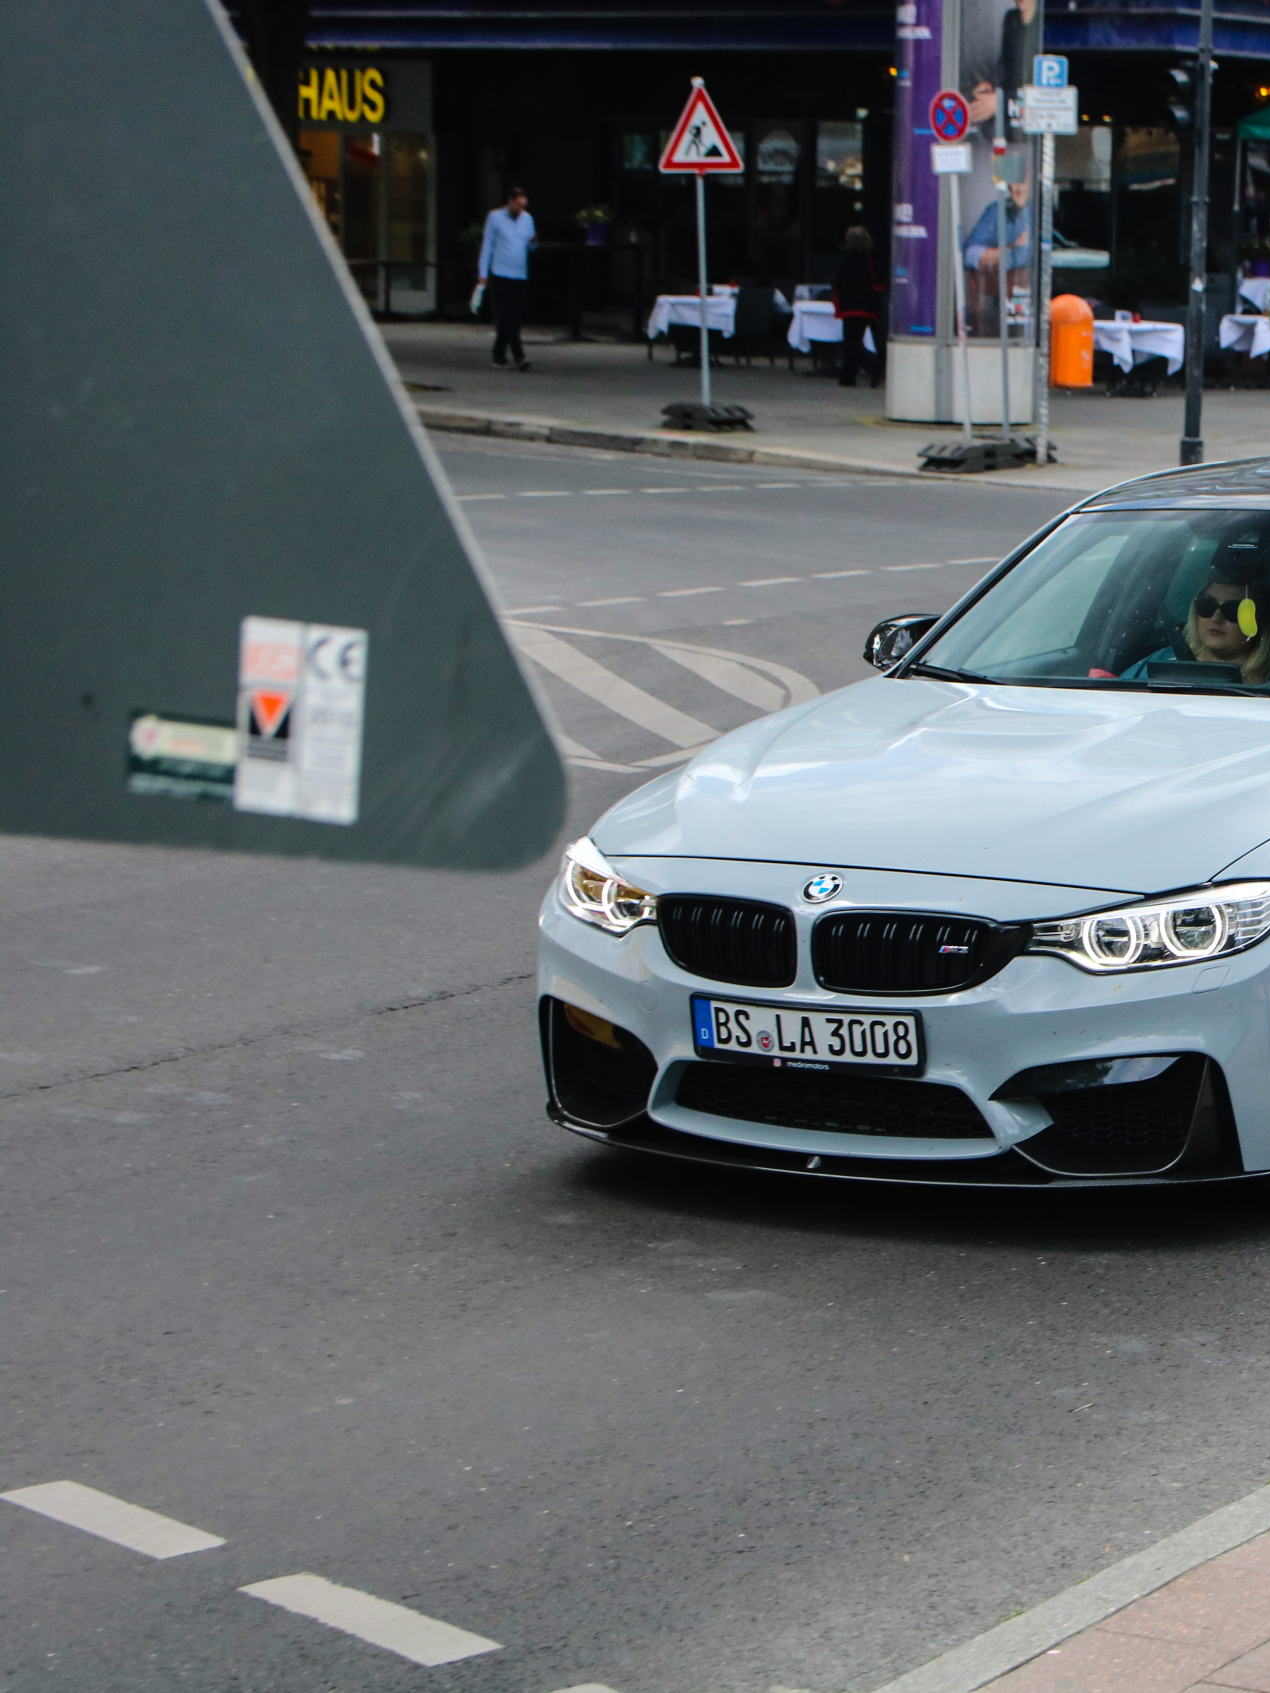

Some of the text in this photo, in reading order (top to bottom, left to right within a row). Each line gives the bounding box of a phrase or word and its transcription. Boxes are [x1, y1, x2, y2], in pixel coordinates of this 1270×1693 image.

[700, 1027, 709, 1040] D
[714, 1006, 913, 1060] BS LA 3008
